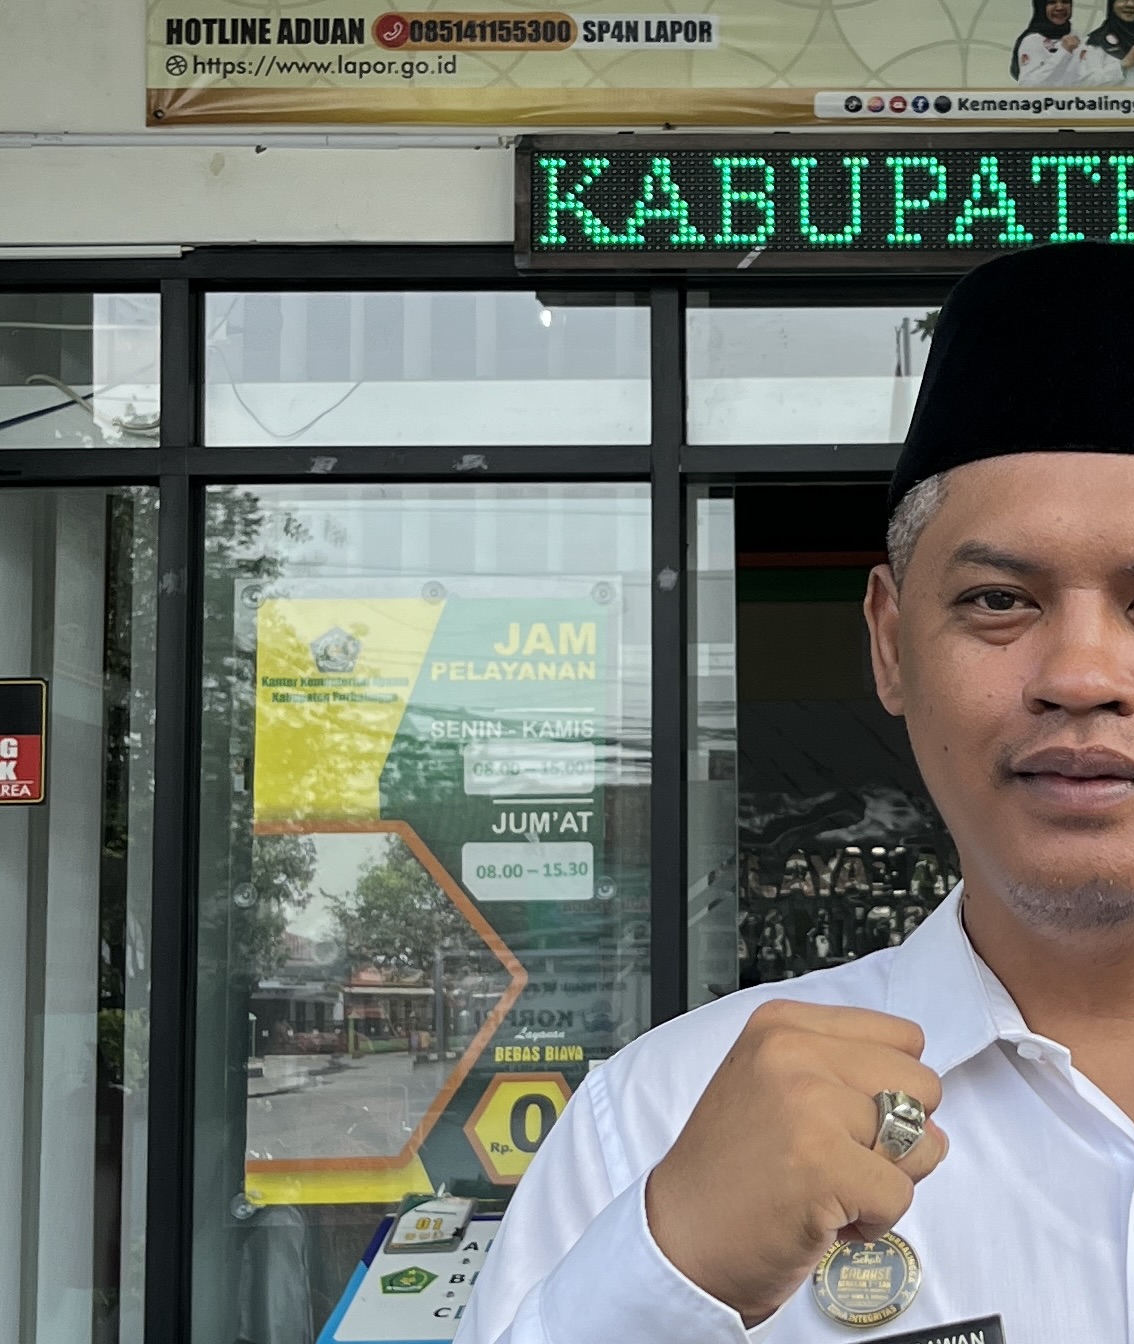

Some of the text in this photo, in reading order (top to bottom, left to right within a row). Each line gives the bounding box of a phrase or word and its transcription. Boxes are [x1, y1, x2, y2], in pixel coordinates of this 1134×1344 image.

[165, 17, 571, 46] HOTLINE ADUAN 085141155300
[583, 19, 713, 44] SP4N LAPOR
[192, 55, 457, 80] https://www.lapor.go.id
[494, 622, 597, 656] JAM
[431, 660, 596, 681] PELAYANAN
[430, 720, 502, 738] SENIN
[523, 719, 595, 738] KAMIS
[0, 784, 31, 797] REA
[492, 810, 594, 834] JUM'AT
[476, 864, 523, 879] 08.00
[543, 862, 589, 877] 15.30
[494, 1044, 584, 1062] BEBAS BIAYA
[490, 1093, 558, 1155] Rp. 0
